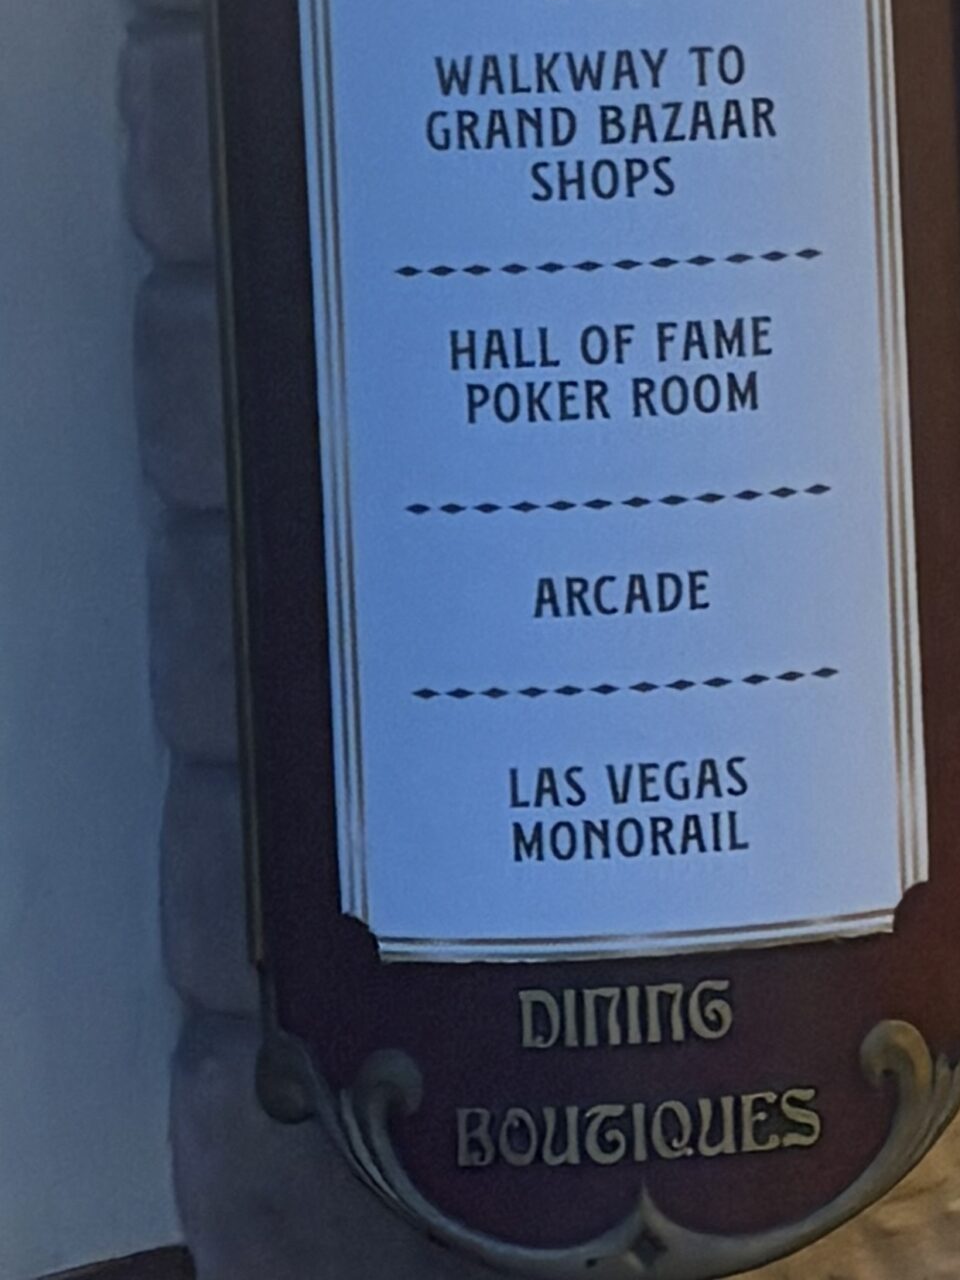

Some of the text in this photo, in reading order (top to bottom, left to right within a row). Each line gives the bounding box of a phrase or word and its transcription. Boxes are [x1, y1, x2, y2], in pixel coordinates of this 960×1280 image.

[434, 44, 745, 97] WALKWAY TO
[426, 97, 777, 151] GRAND BAZAAR
[531, 156, 675, 202] SHOPS
[450, 316, 773, 371] HALL OF FAME
[466, 370, 759, 424] POKER ROOM
[533, 570, 710, 619] ARCADE
[509, 756, 748, 808] LAS VEGAS
[512, 810, 749, 862] MONORAIL
[517, 978, 736, 1050] DINING
[455, 1086, 824, 1170] BOUTIQUES
